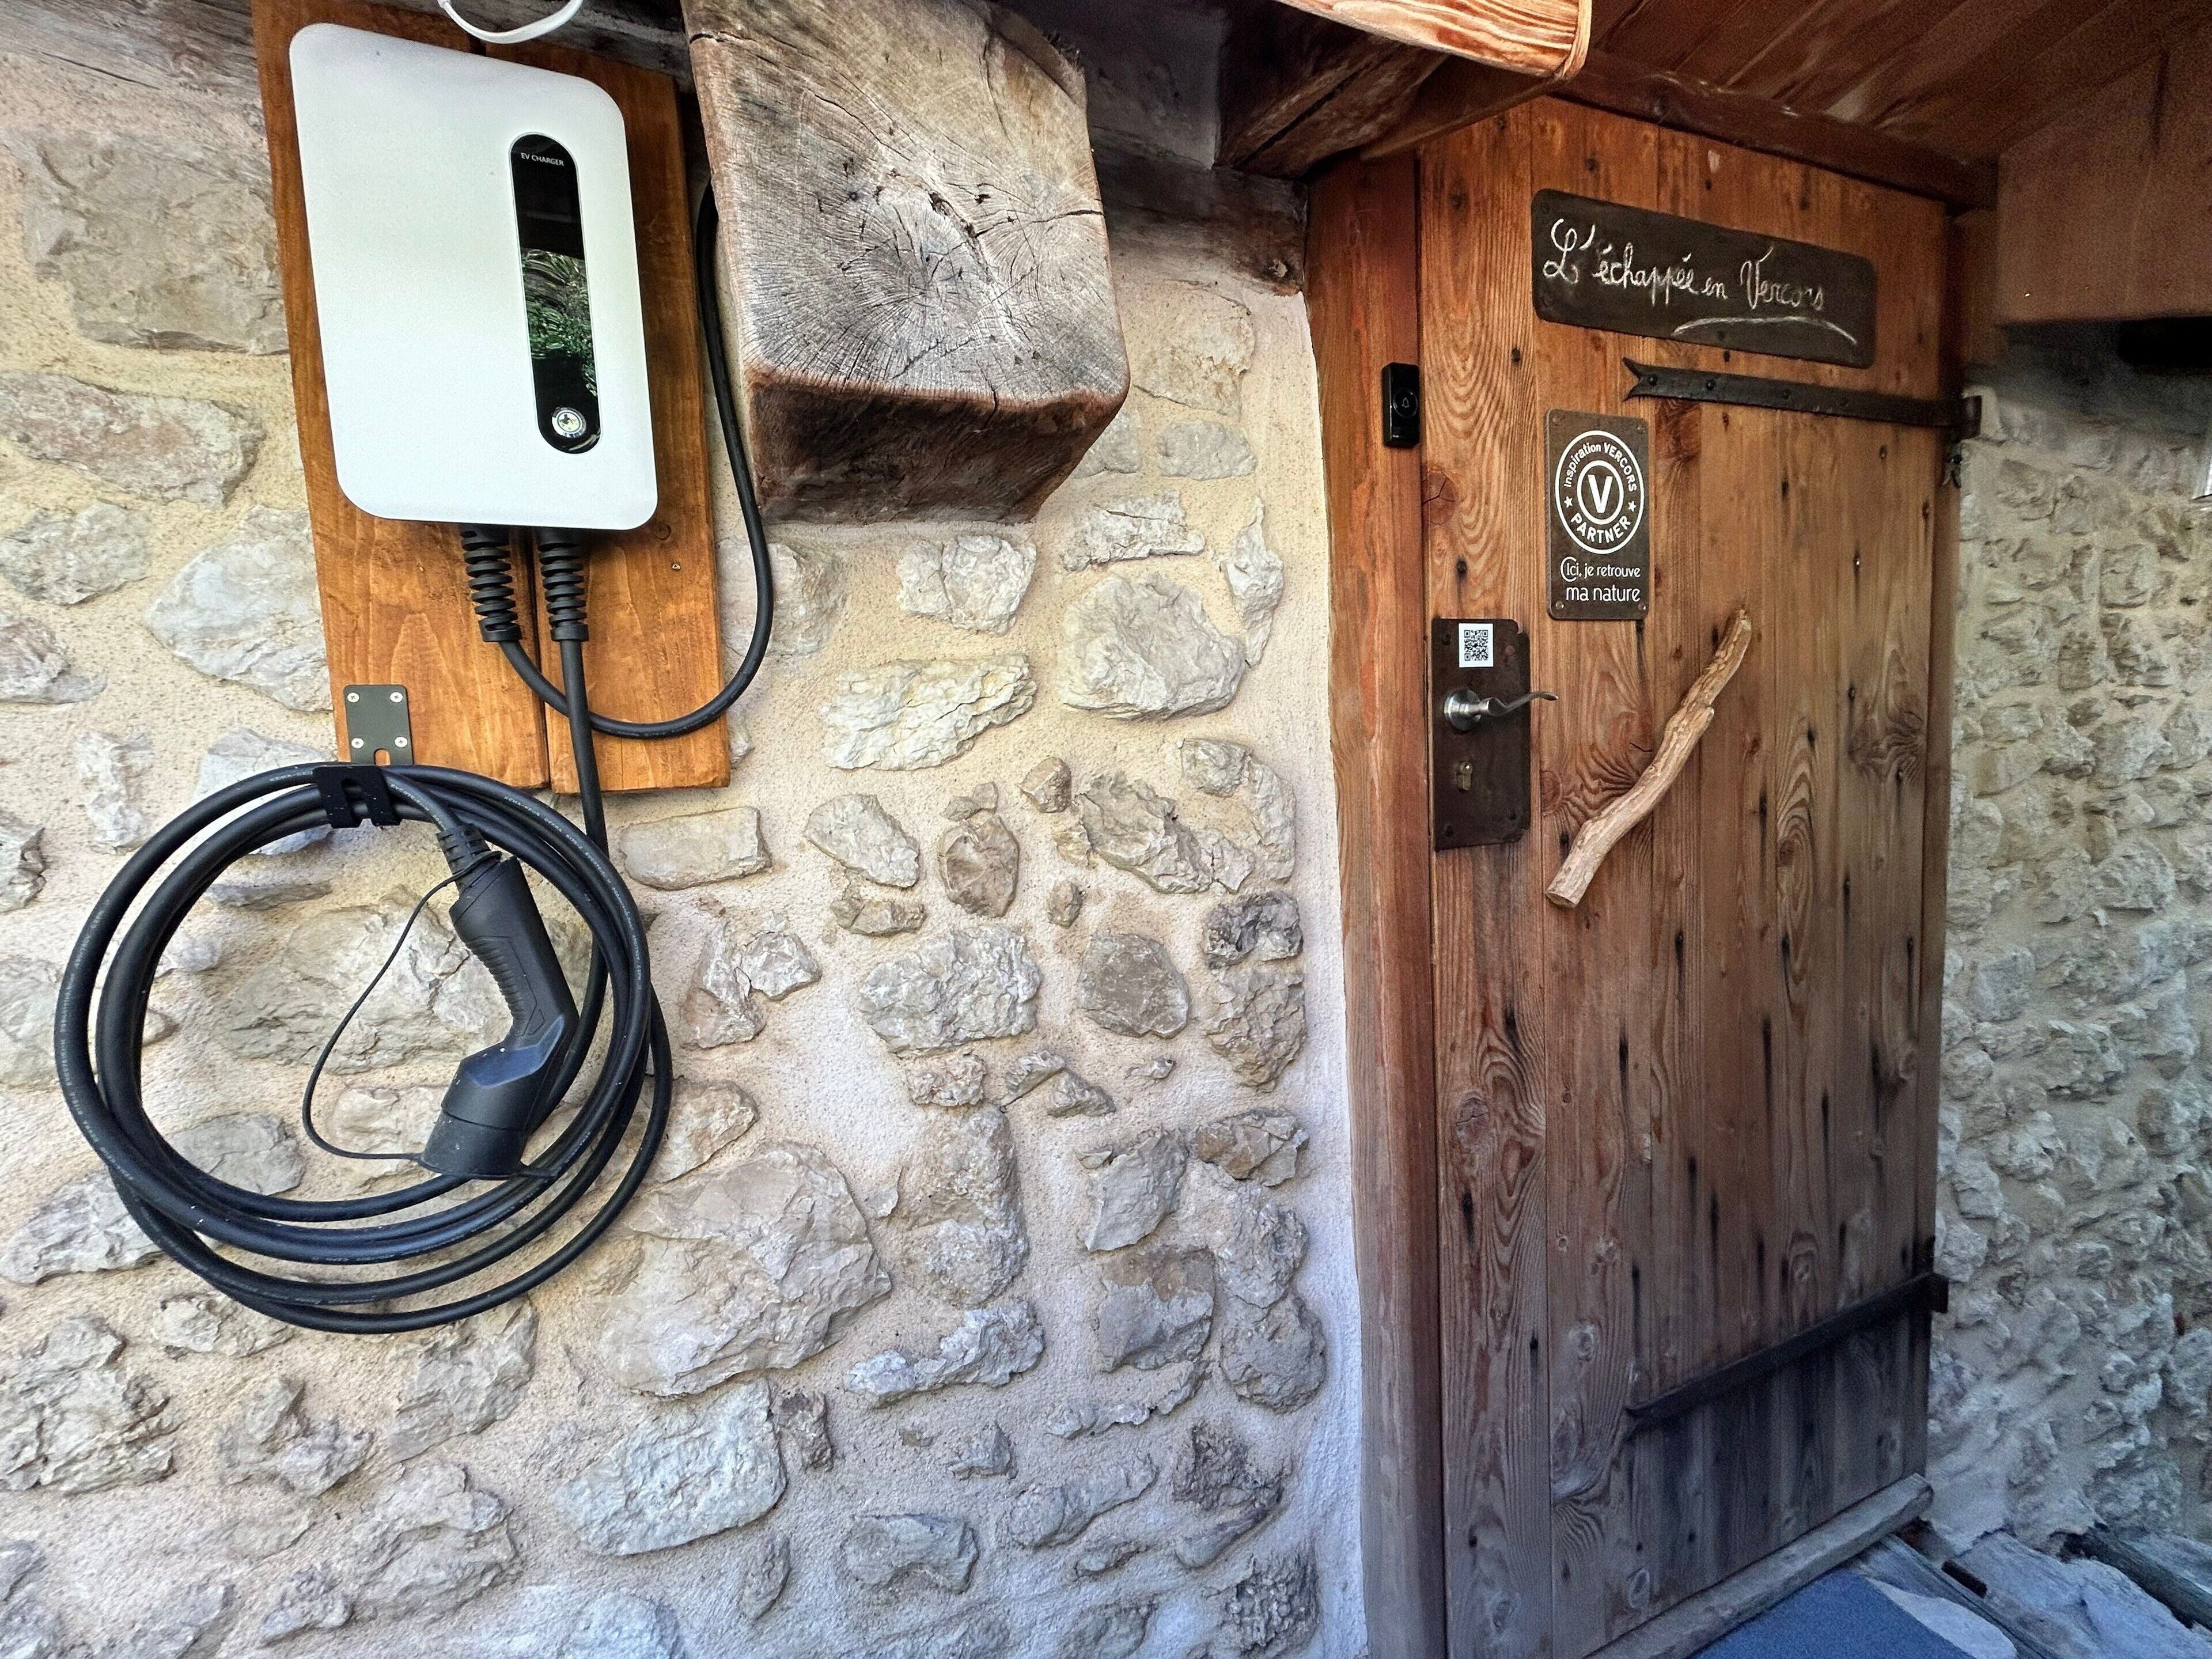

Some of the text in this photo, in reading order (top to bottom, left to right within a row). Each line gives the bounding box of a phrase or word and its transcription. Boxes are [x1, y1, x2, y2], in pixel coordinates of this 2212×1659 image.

[531, 154, 565, 166] CHARGER
[1702, 276, 1728, 300] en
[1740, 245, 1825, 311] Vercors
[1563, 442, 1637, 492] Inspiration VERCORS
[1588, 474, 1613, 513] V
[1570, 512, 1631, 543] PARTNER
[1584, 563, 1594, 579] je
[1597, 564, 1641, 578] retrouve
[1566, 584, 1641, 603] ma nature
